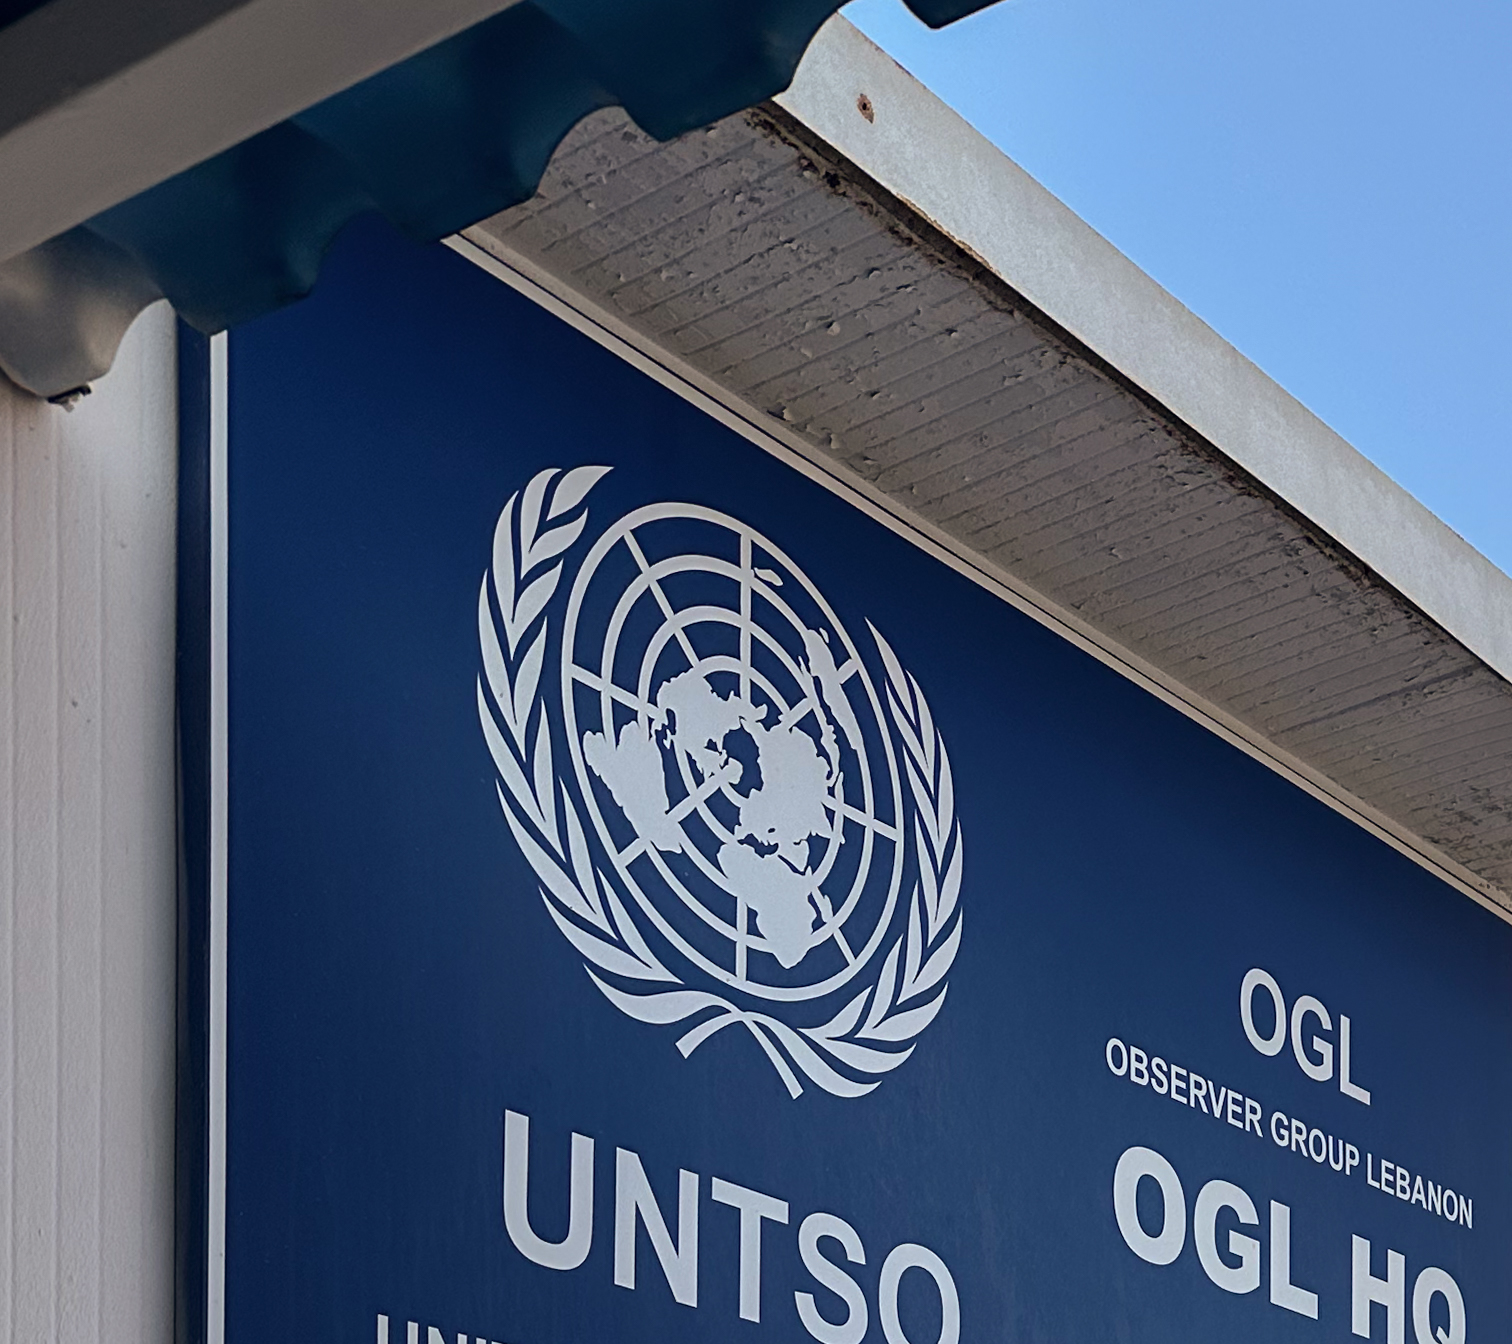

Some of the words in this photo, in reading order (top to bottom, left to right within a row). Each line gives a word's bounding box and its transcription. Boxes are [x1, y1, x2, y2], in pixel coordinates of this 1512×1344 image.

[1240, 968, 1371, 1106] OGL
[1106, 1037, 1264, 1138] OBSERVER
[1270, 1111, 1360, 1176] GROUP
[1367, 1152, 1474, 1229] LEBANON
[1113, 1146, 1319, 1320] OGL
